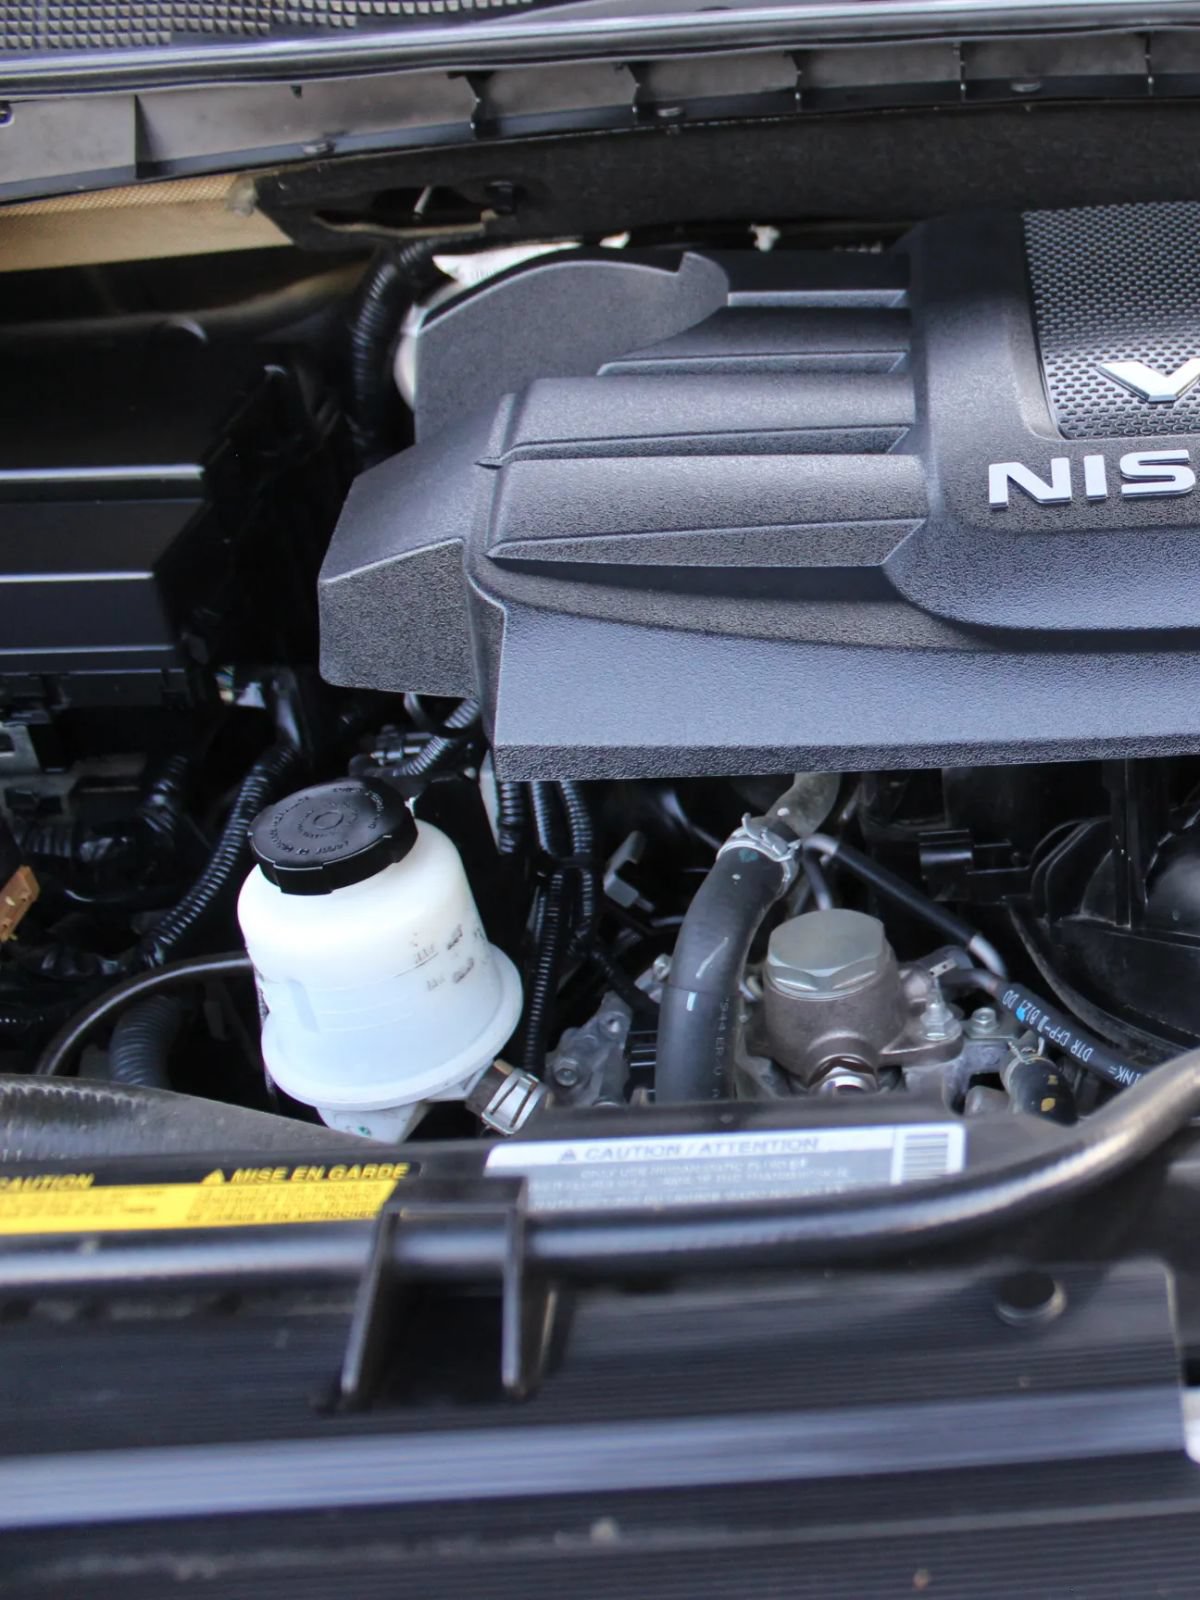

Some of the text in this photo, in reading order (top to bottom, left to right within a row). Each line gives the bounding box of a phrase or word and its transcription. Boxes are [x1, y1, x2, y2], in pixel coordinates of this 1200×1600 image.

[584, 1145, 680, 1161] CAUTION
[699, 1137, 820, 1154] ATTENTION
[230, 1162, 411, 1185] MISE EN GARDE
